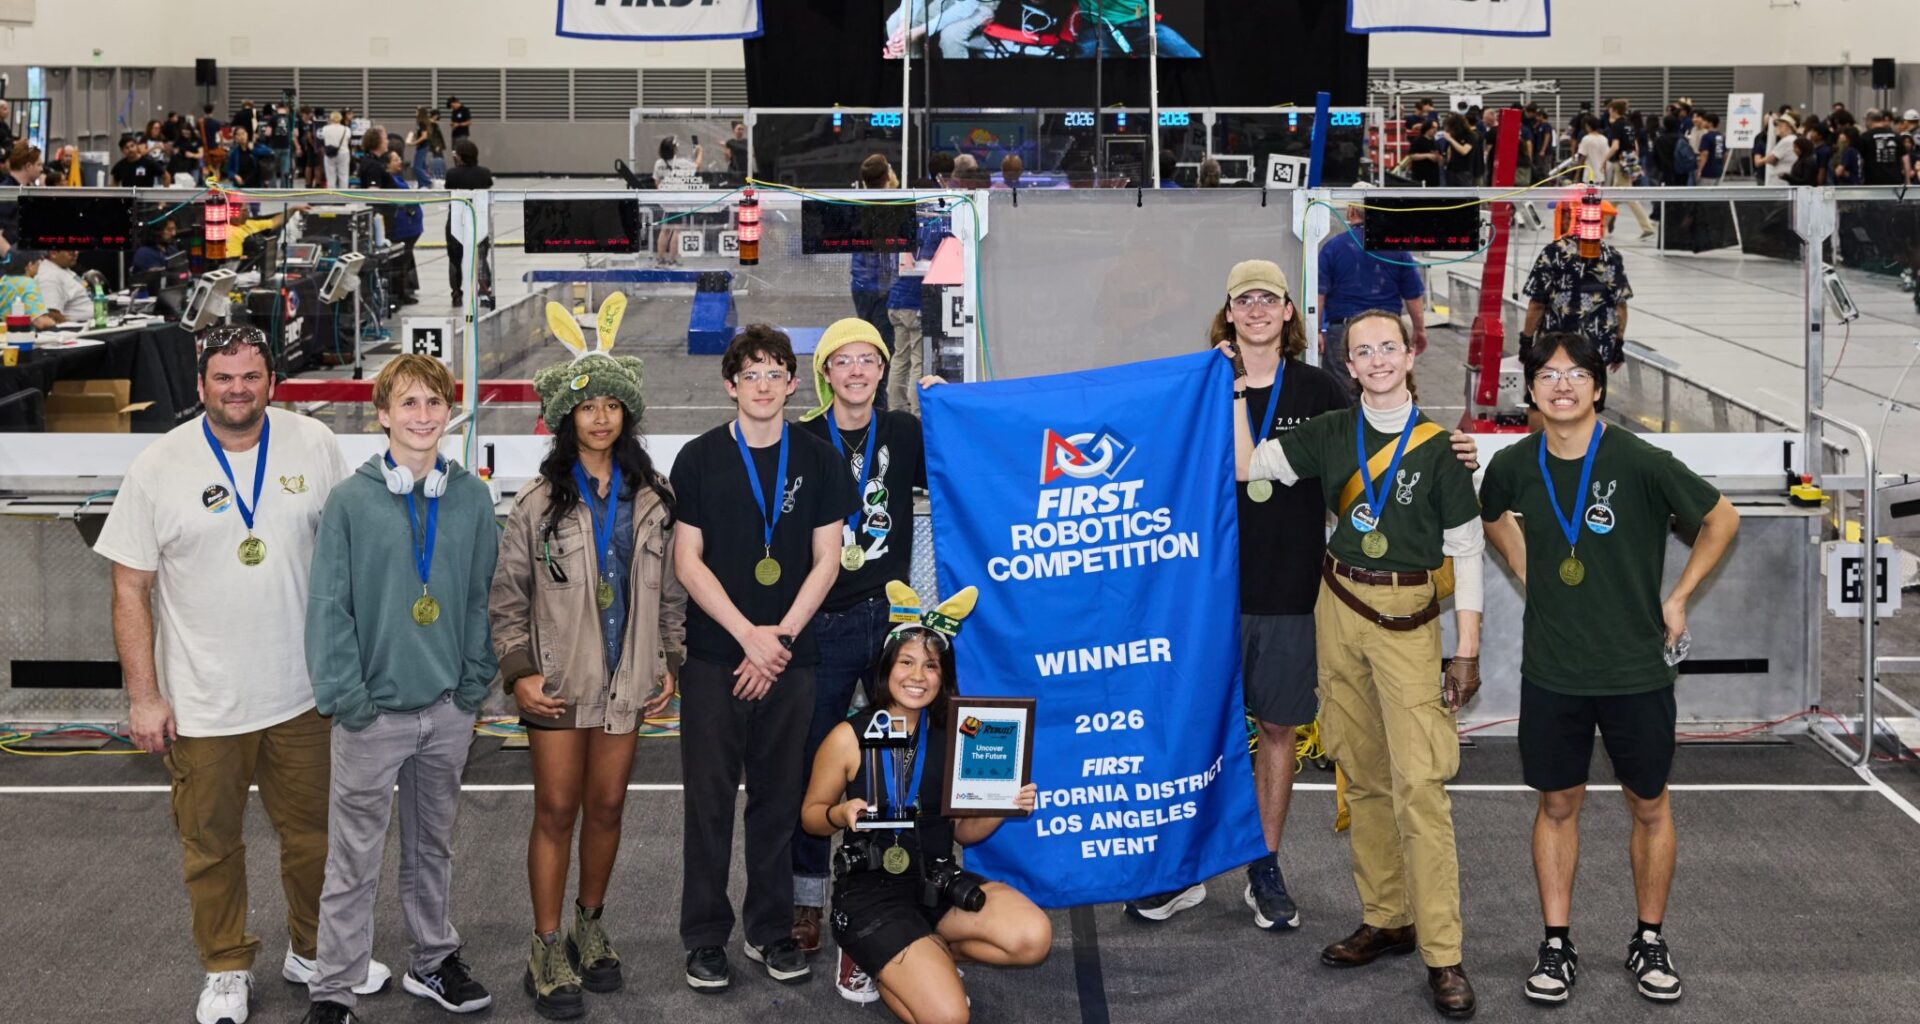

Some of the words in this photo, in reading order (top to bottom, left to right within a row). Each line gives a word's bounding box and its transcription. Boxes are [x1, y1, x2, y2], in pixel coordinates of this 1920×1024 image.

[871, 112, 901, 126] 2026
[1064, 112, 1095, 126] 2026
[1159, 112, 1190, 126] 2026
[1331, 112, 1361, 126] 2026
[1036, 479, 1144, 519] FIRST
[1011, 507, 1172, 551] ROBOTICS
[987, 532, 1199, 582] COMPETITION
[1035, 637, 1172, 677] WINNER
[1075, 709, 1145, 734] 2026
[972, 752, 984, 760] The
[985, 752, 1007, 760] Future
[1082, 756, 1144, 777] FIRST
[1034, 784, 1129, 810] IFORNIA
[1135, 755, 1223, 801] DISTRICT
[1036, 814, 1083, 837] LOS
[1090, 801, 1198, 831] ANGELES
[1081, 834, 1159, 859] EVENT
